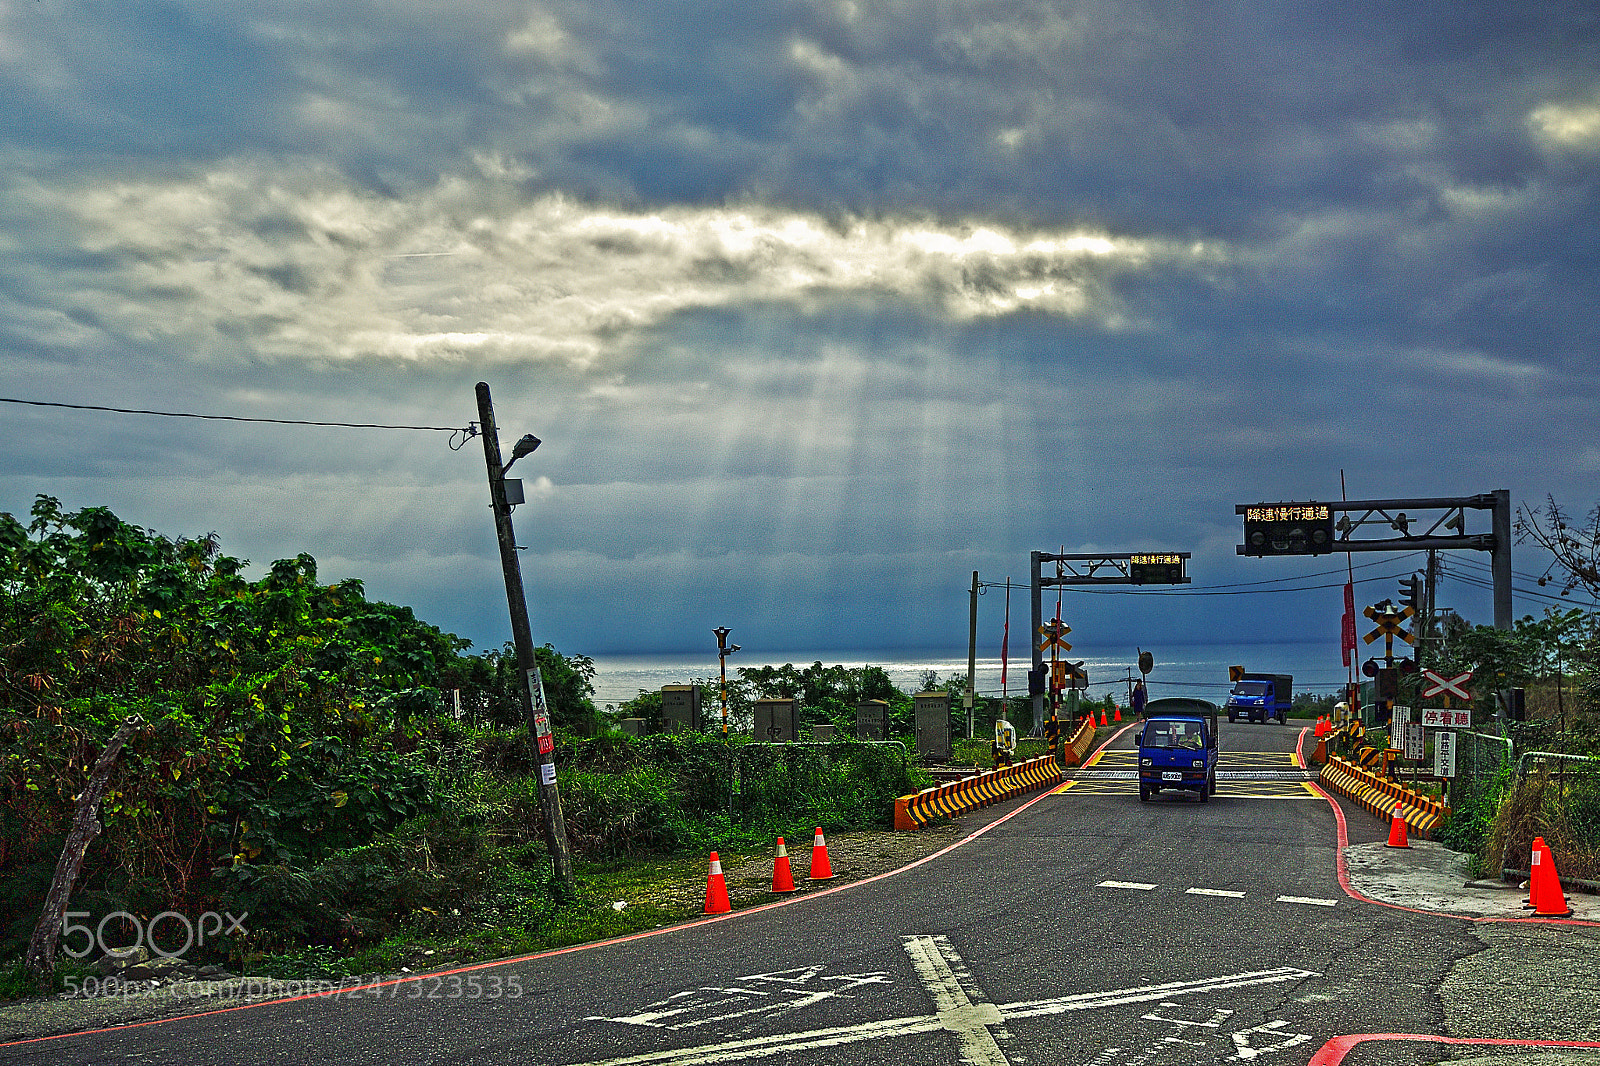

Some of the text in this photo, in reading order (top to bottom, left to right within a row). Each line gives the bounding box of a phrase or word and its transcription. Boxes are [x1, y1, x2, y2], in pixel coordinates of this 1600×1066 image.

[1247, 505, 1329, 522] 降速慢行通過
[1424, 710, 1469, 726] 停看聽
